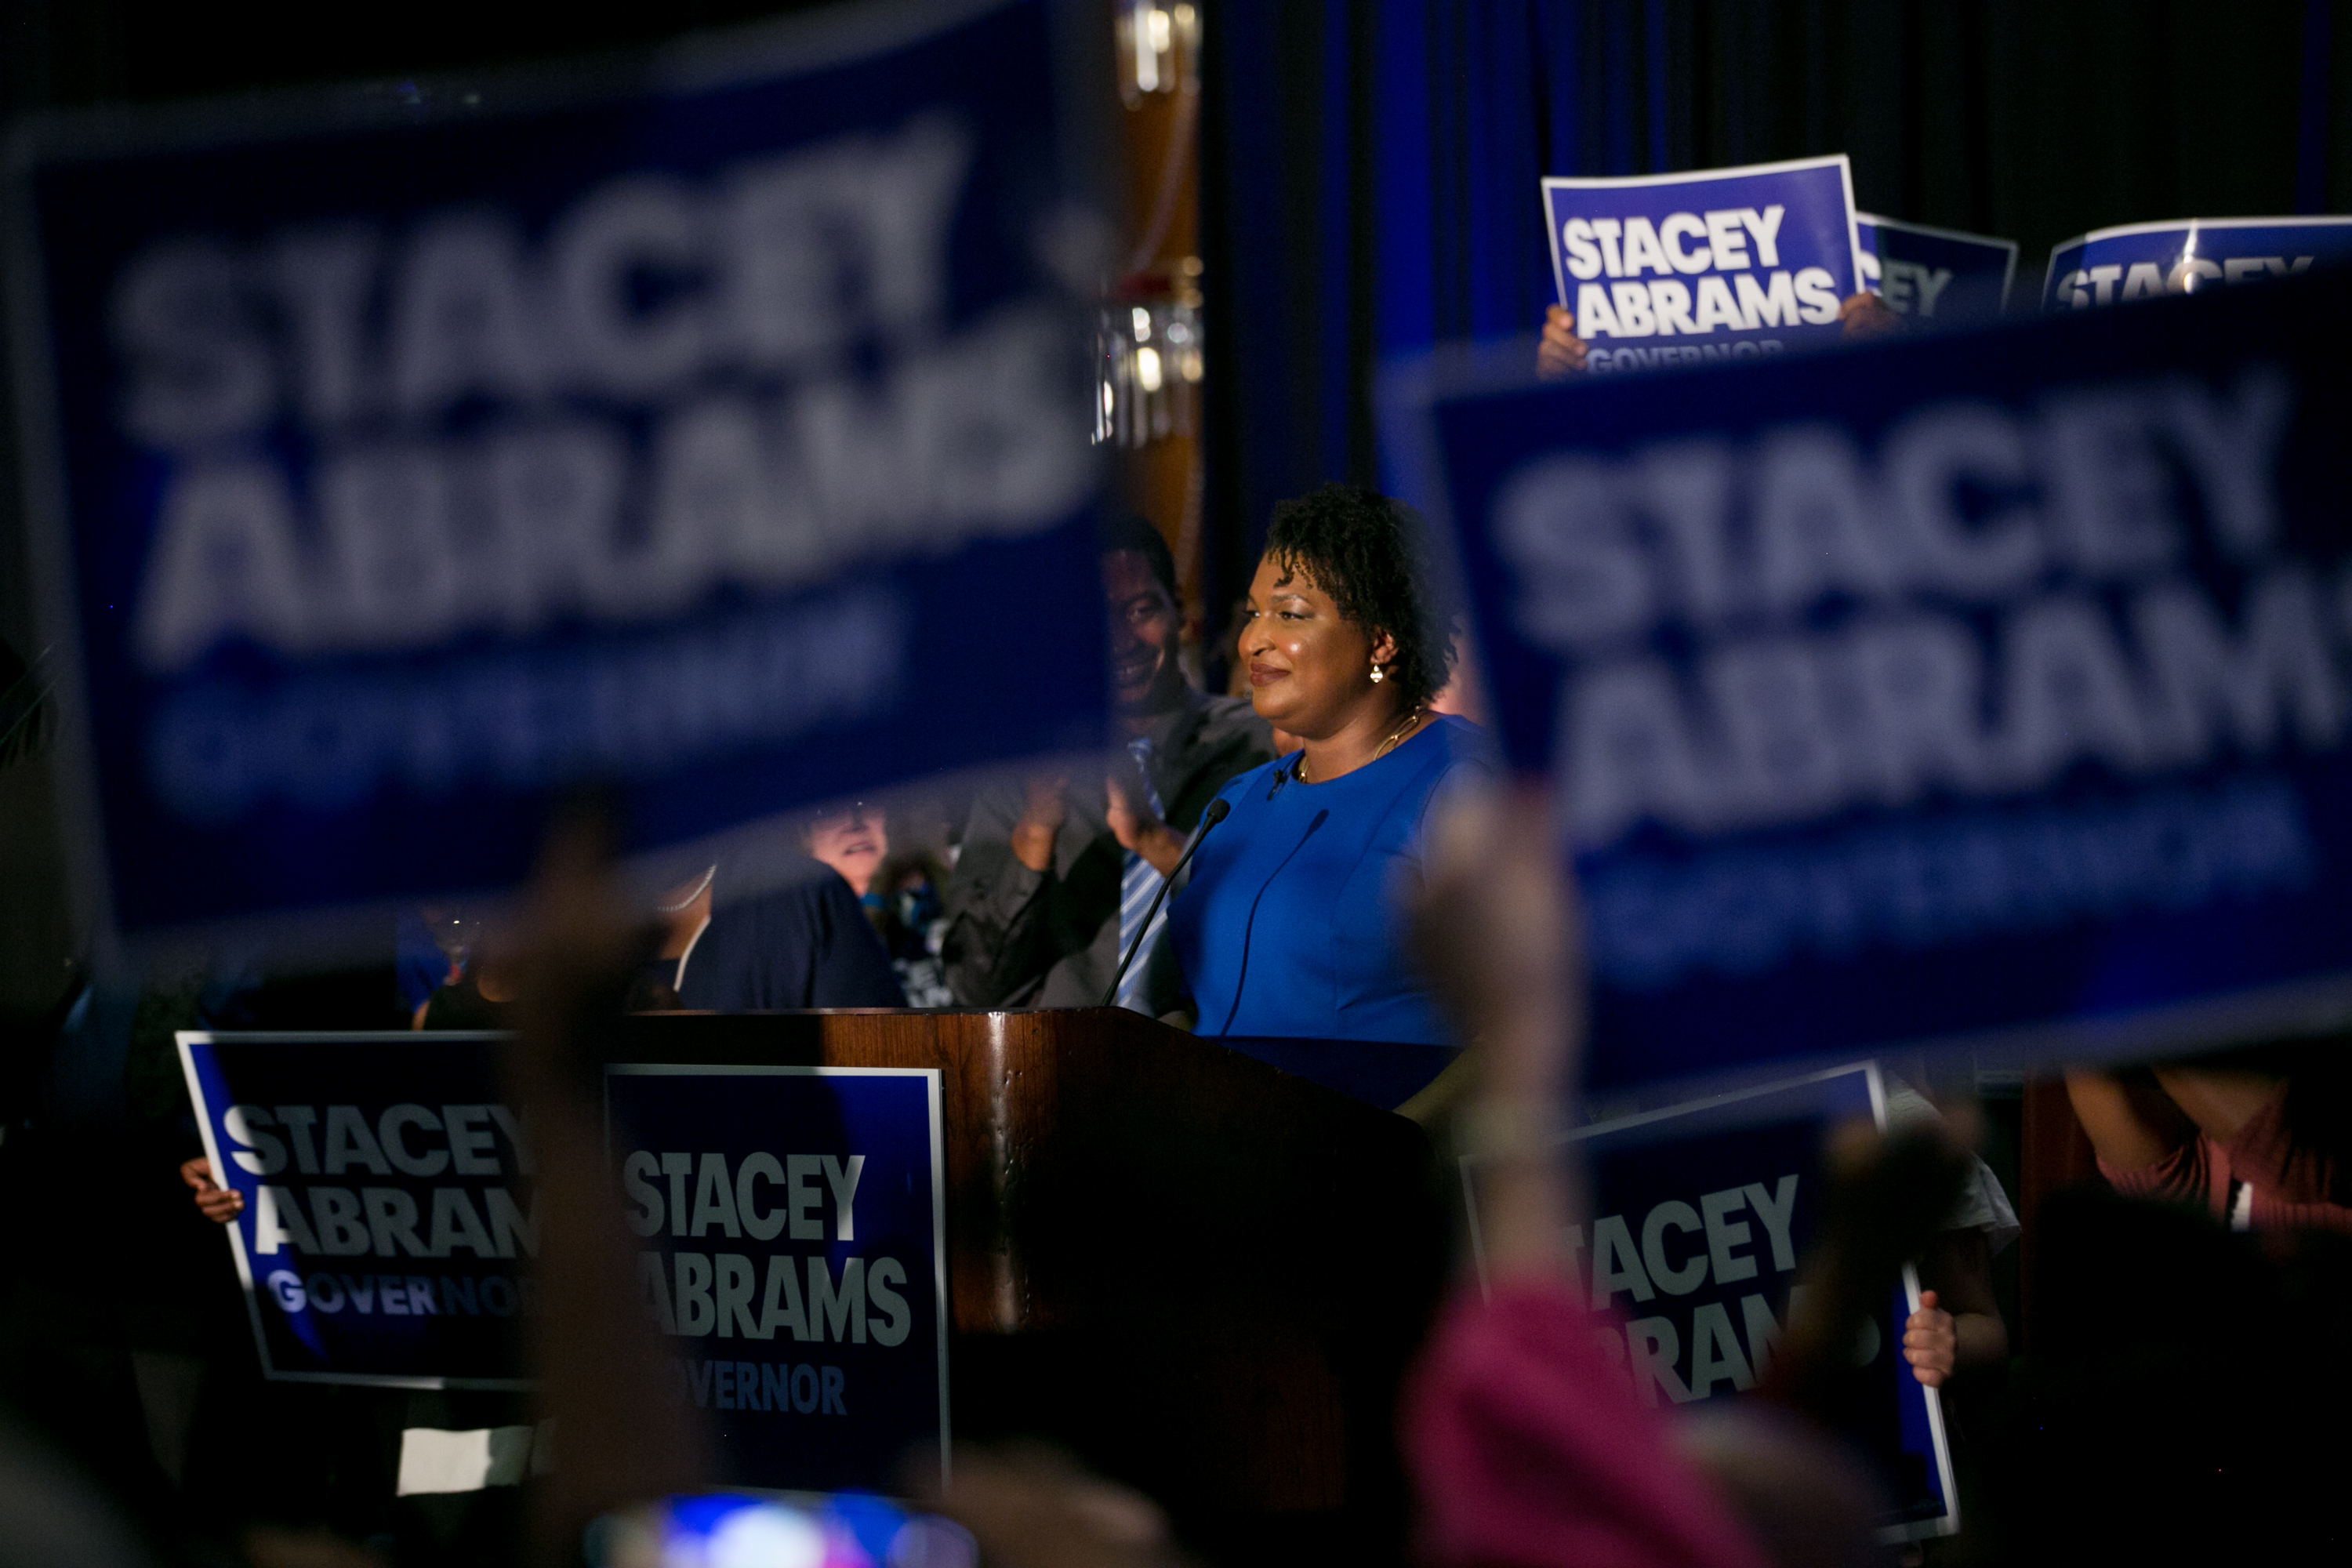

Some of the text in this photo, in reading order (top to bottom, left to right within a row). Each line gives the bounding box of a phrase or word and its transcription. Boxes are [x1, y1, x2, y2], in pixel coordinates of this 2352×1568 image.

[106, 110, 976, 459] STACEY
[1563, 204, 1785, 280] STACEY
[1577, 267, 1841, 339] ABRAMS
[129, 294, 1098, 674] ABRAMS
[1492, 362, 2296, 657] STACEY
[1555, 555, 2352, 851] ABRAM
[255, 1184, 541, 1259] ABRAM
[624, 1149, 866, 1242] STACEY
[1564, 1173, 1800, 1313] ACEY
[267, 1269, 525, 1318] GOVERNO
[637, 1250, 912, 1348] ABRAMS
[670, 1359, 848, 1416] VERNOR
